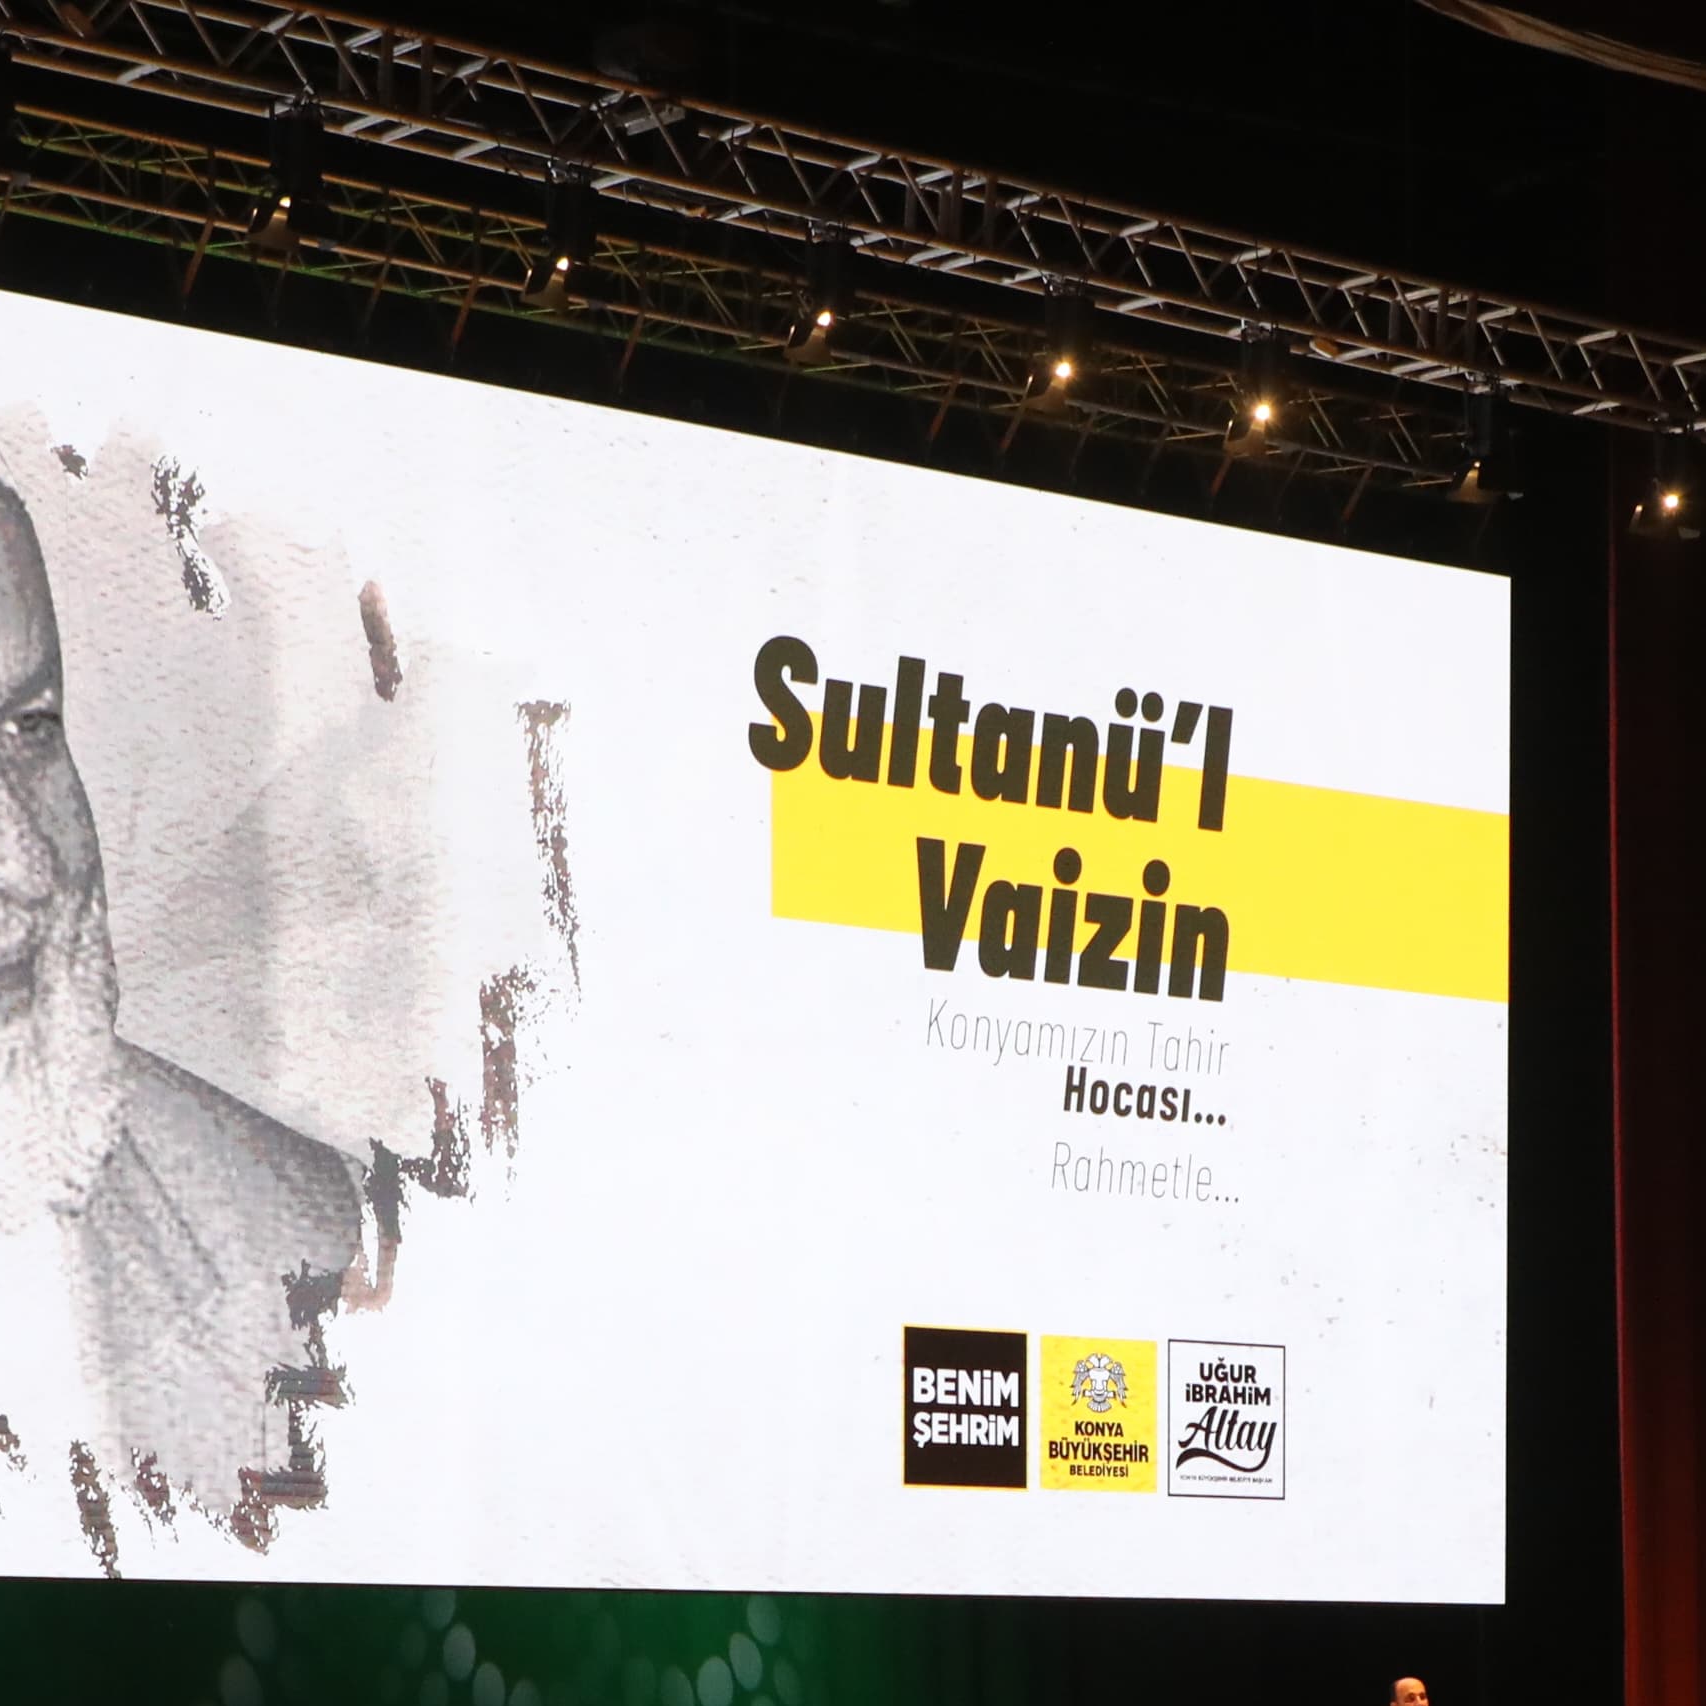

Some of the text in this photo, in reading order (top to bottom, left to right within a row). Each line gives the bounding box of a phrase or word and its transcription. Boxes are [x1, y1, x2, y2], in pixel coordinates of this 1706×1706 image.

[749, 636, 1233, 831] Sultanü'l
[917, 838, 1229, 1001] Vaizin
[927, 998, 1230, 1075] Konyamızın Tahir
[1063, 1066, 1226, 1126] Hocası...
[1051, 1142, 1239, 1203] Rahmetle...
[913, 1367, 1019, 1408] BENİM
[1199, 1357, 1257, 1384] UĞUR
[912, 1411, 1019, 1448] ŞEHRİM
[1048, 1437, 1149, 1463] BÜYÜKŞEHİR
[1074, 1420, 1124, 1438] KONYA
[1176, 1406, 1277, 1472] Altay
[1069, 1463, 1129, 1478] BELEDİYESİ
